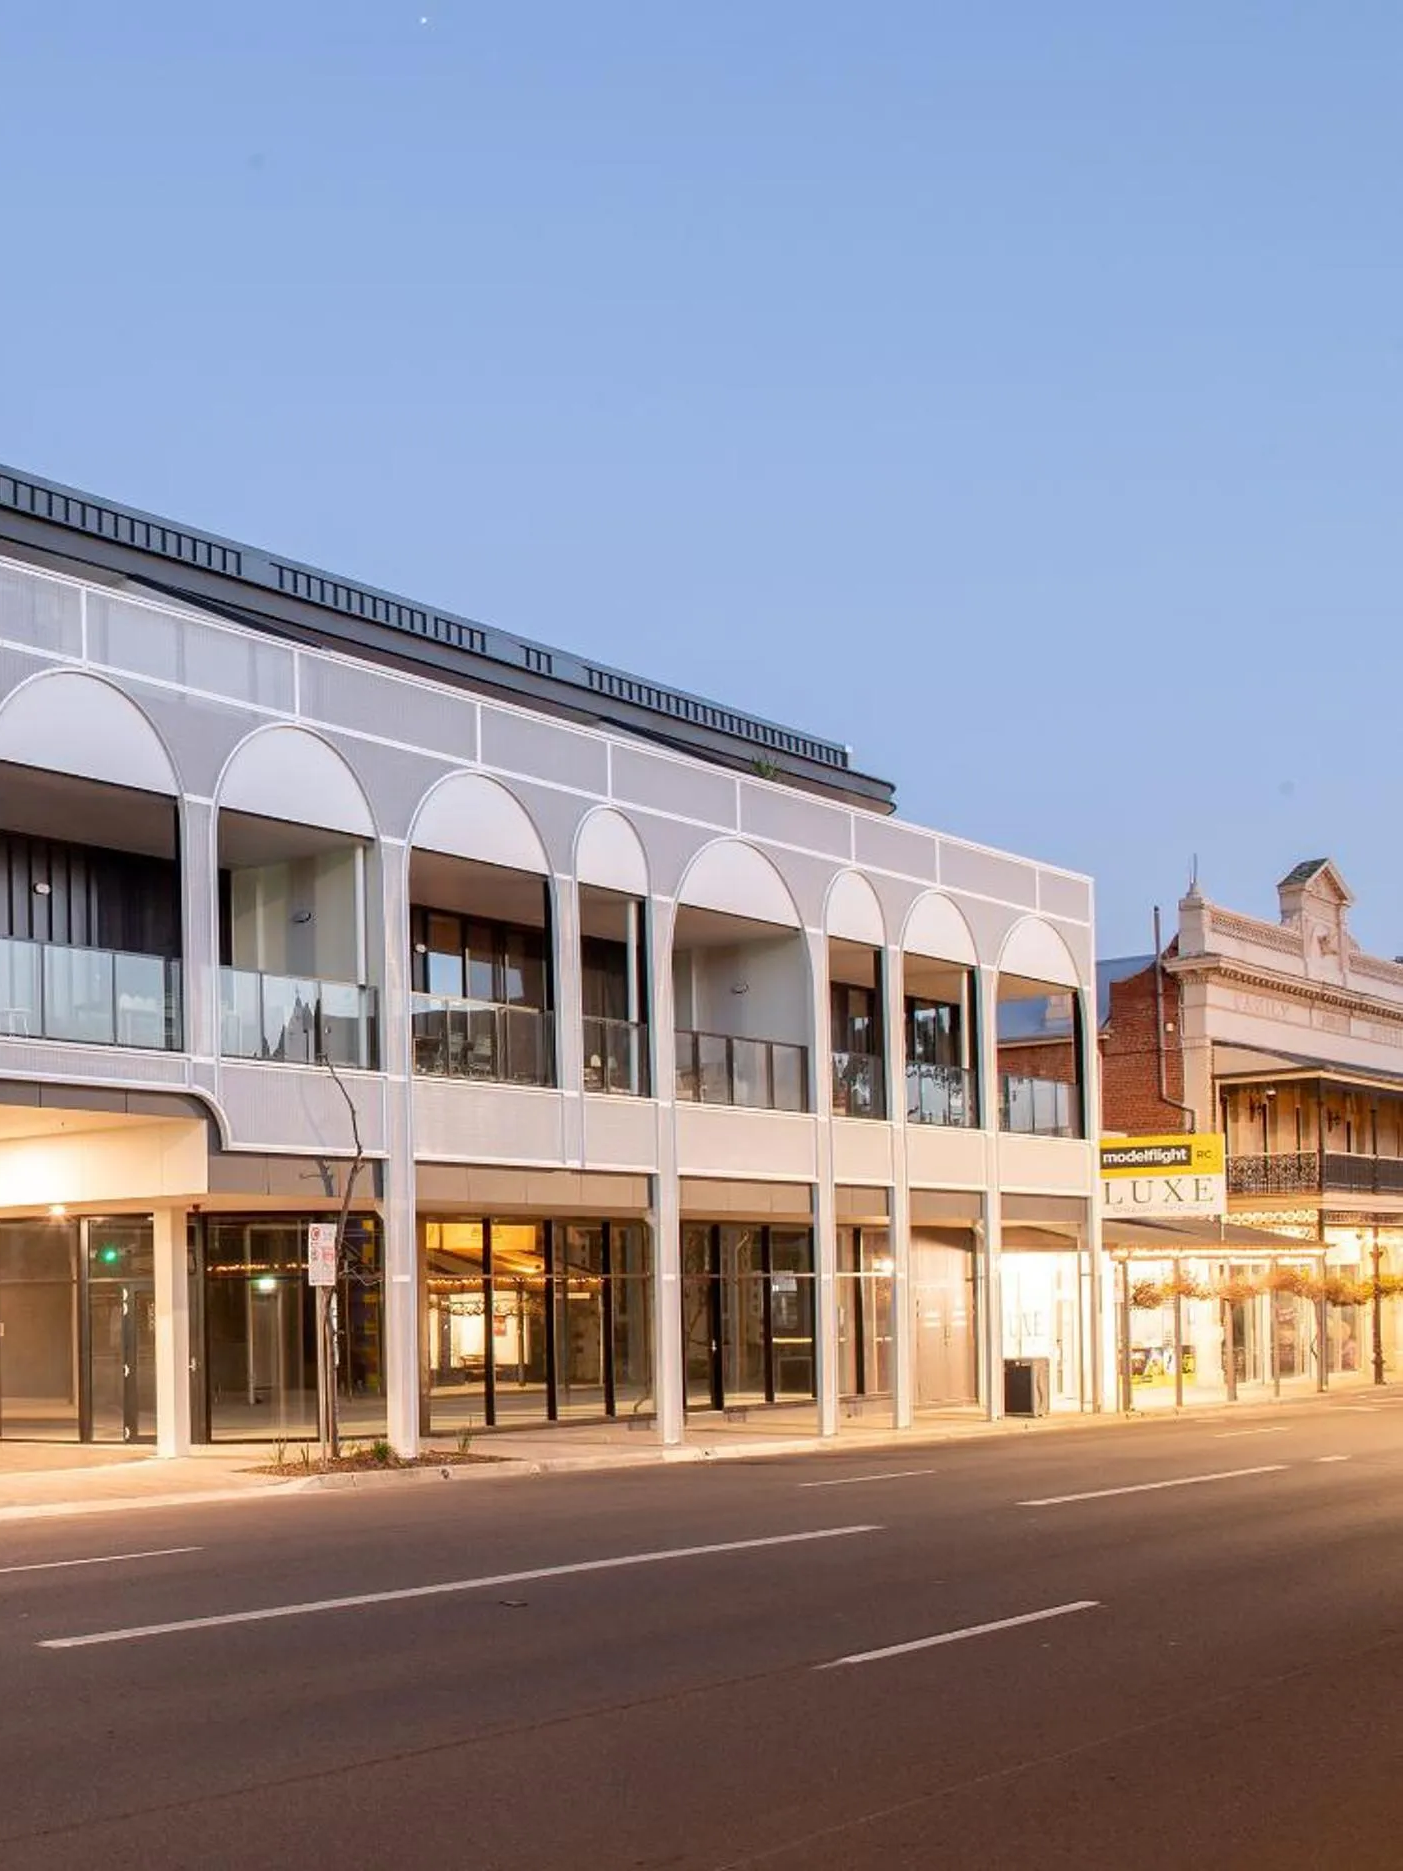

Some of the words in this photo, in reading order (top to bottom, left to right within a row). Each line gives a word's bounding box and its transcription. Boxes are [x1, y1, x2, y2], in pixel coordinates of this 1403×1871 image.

[1103, 1148, 1187, 1164] modelflight
[1196, 1150, 1212, 1160] RC
[1104, 1177, 1215, 1205] LUXE
